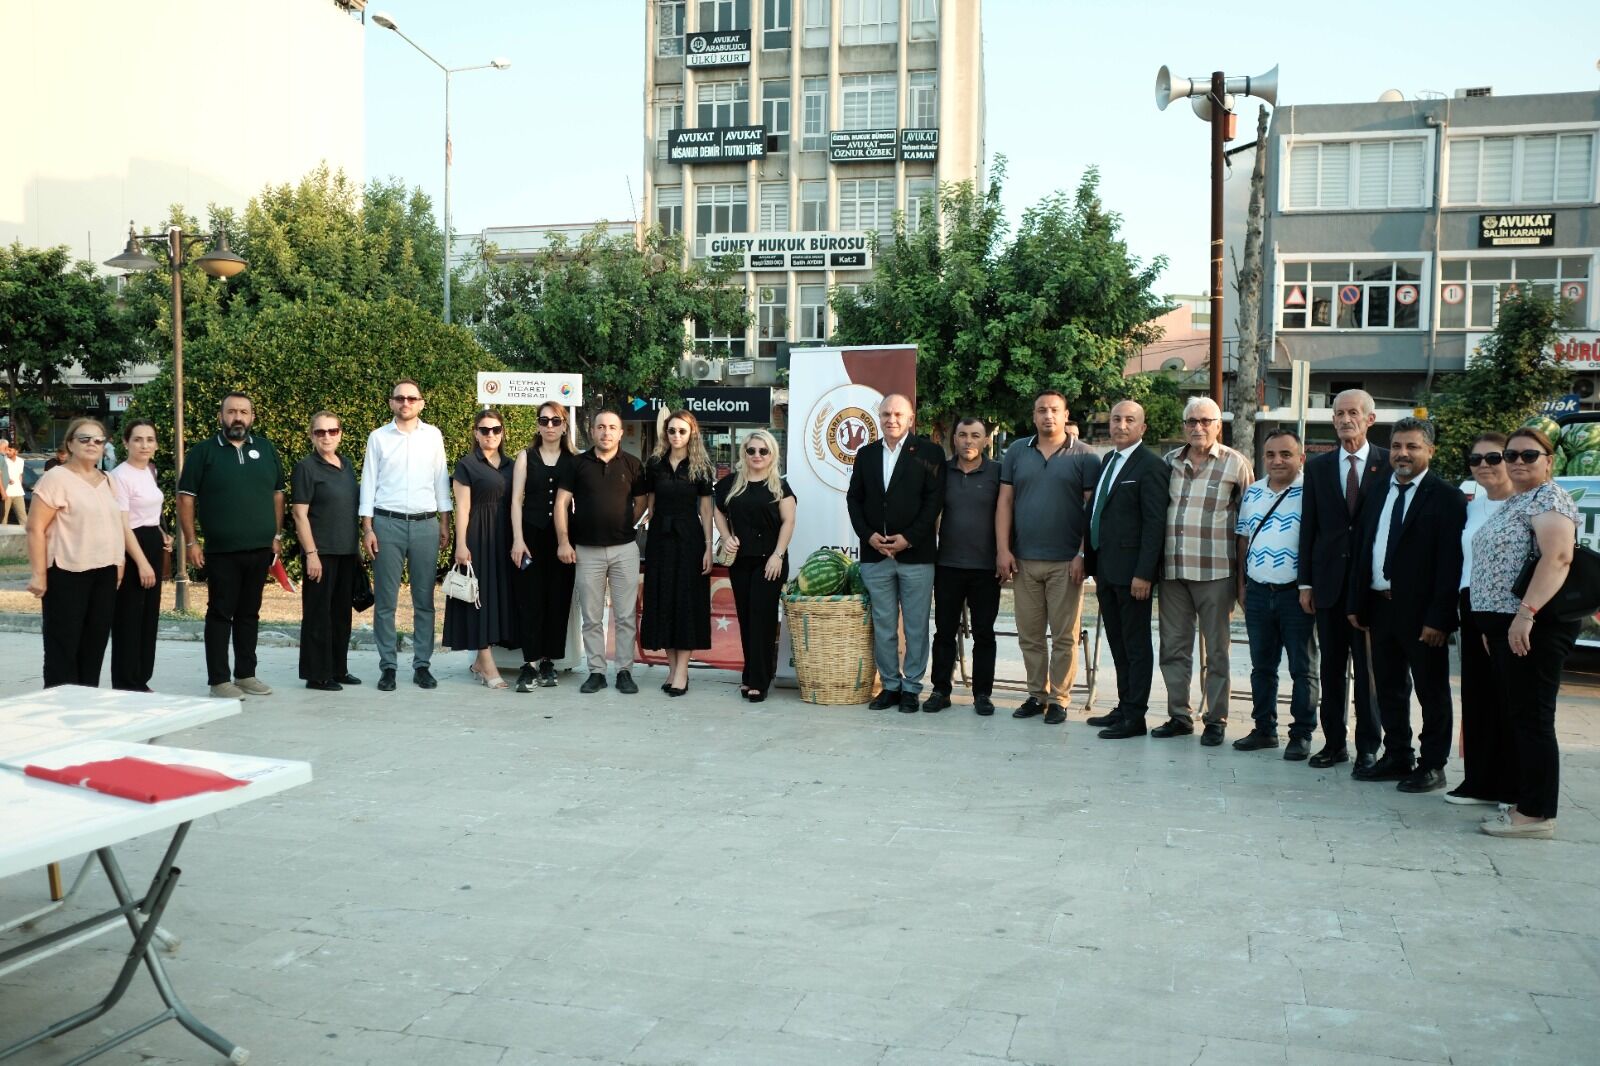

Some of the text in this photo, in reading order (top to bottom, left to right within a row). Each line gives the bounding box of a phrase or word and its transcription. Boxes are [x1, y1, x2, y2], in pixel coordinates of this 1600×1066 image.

[713, 36, 740, 44] AVUKAT
[706, 43, 747, 52] ARABULUCU
[691, 53, 746, 65] ÜLKÜ KURT
[677, 132, 714, 142] AVUKAT
[725, 130, 762, 140] AVUKAT
[906, 132, 934, 140] AVUKAT
[672, 144, 720, 158] NİSANUR DEMİR
[724, 142, 763, 156] TUTKU TÜRE
[834, 147, 892, 157] ÖZNUR ÖZBEK
[1499, 215, 1552, 227] AVUKAT
[1483, 228, 1553, 238] SALİH KARAHAN
[712, 234, 865, 252] GÜNEY HUKUK BÜROSU
[839, 256, 857, 264] Kat:2
[686, 398, 750, 412] Telekom
